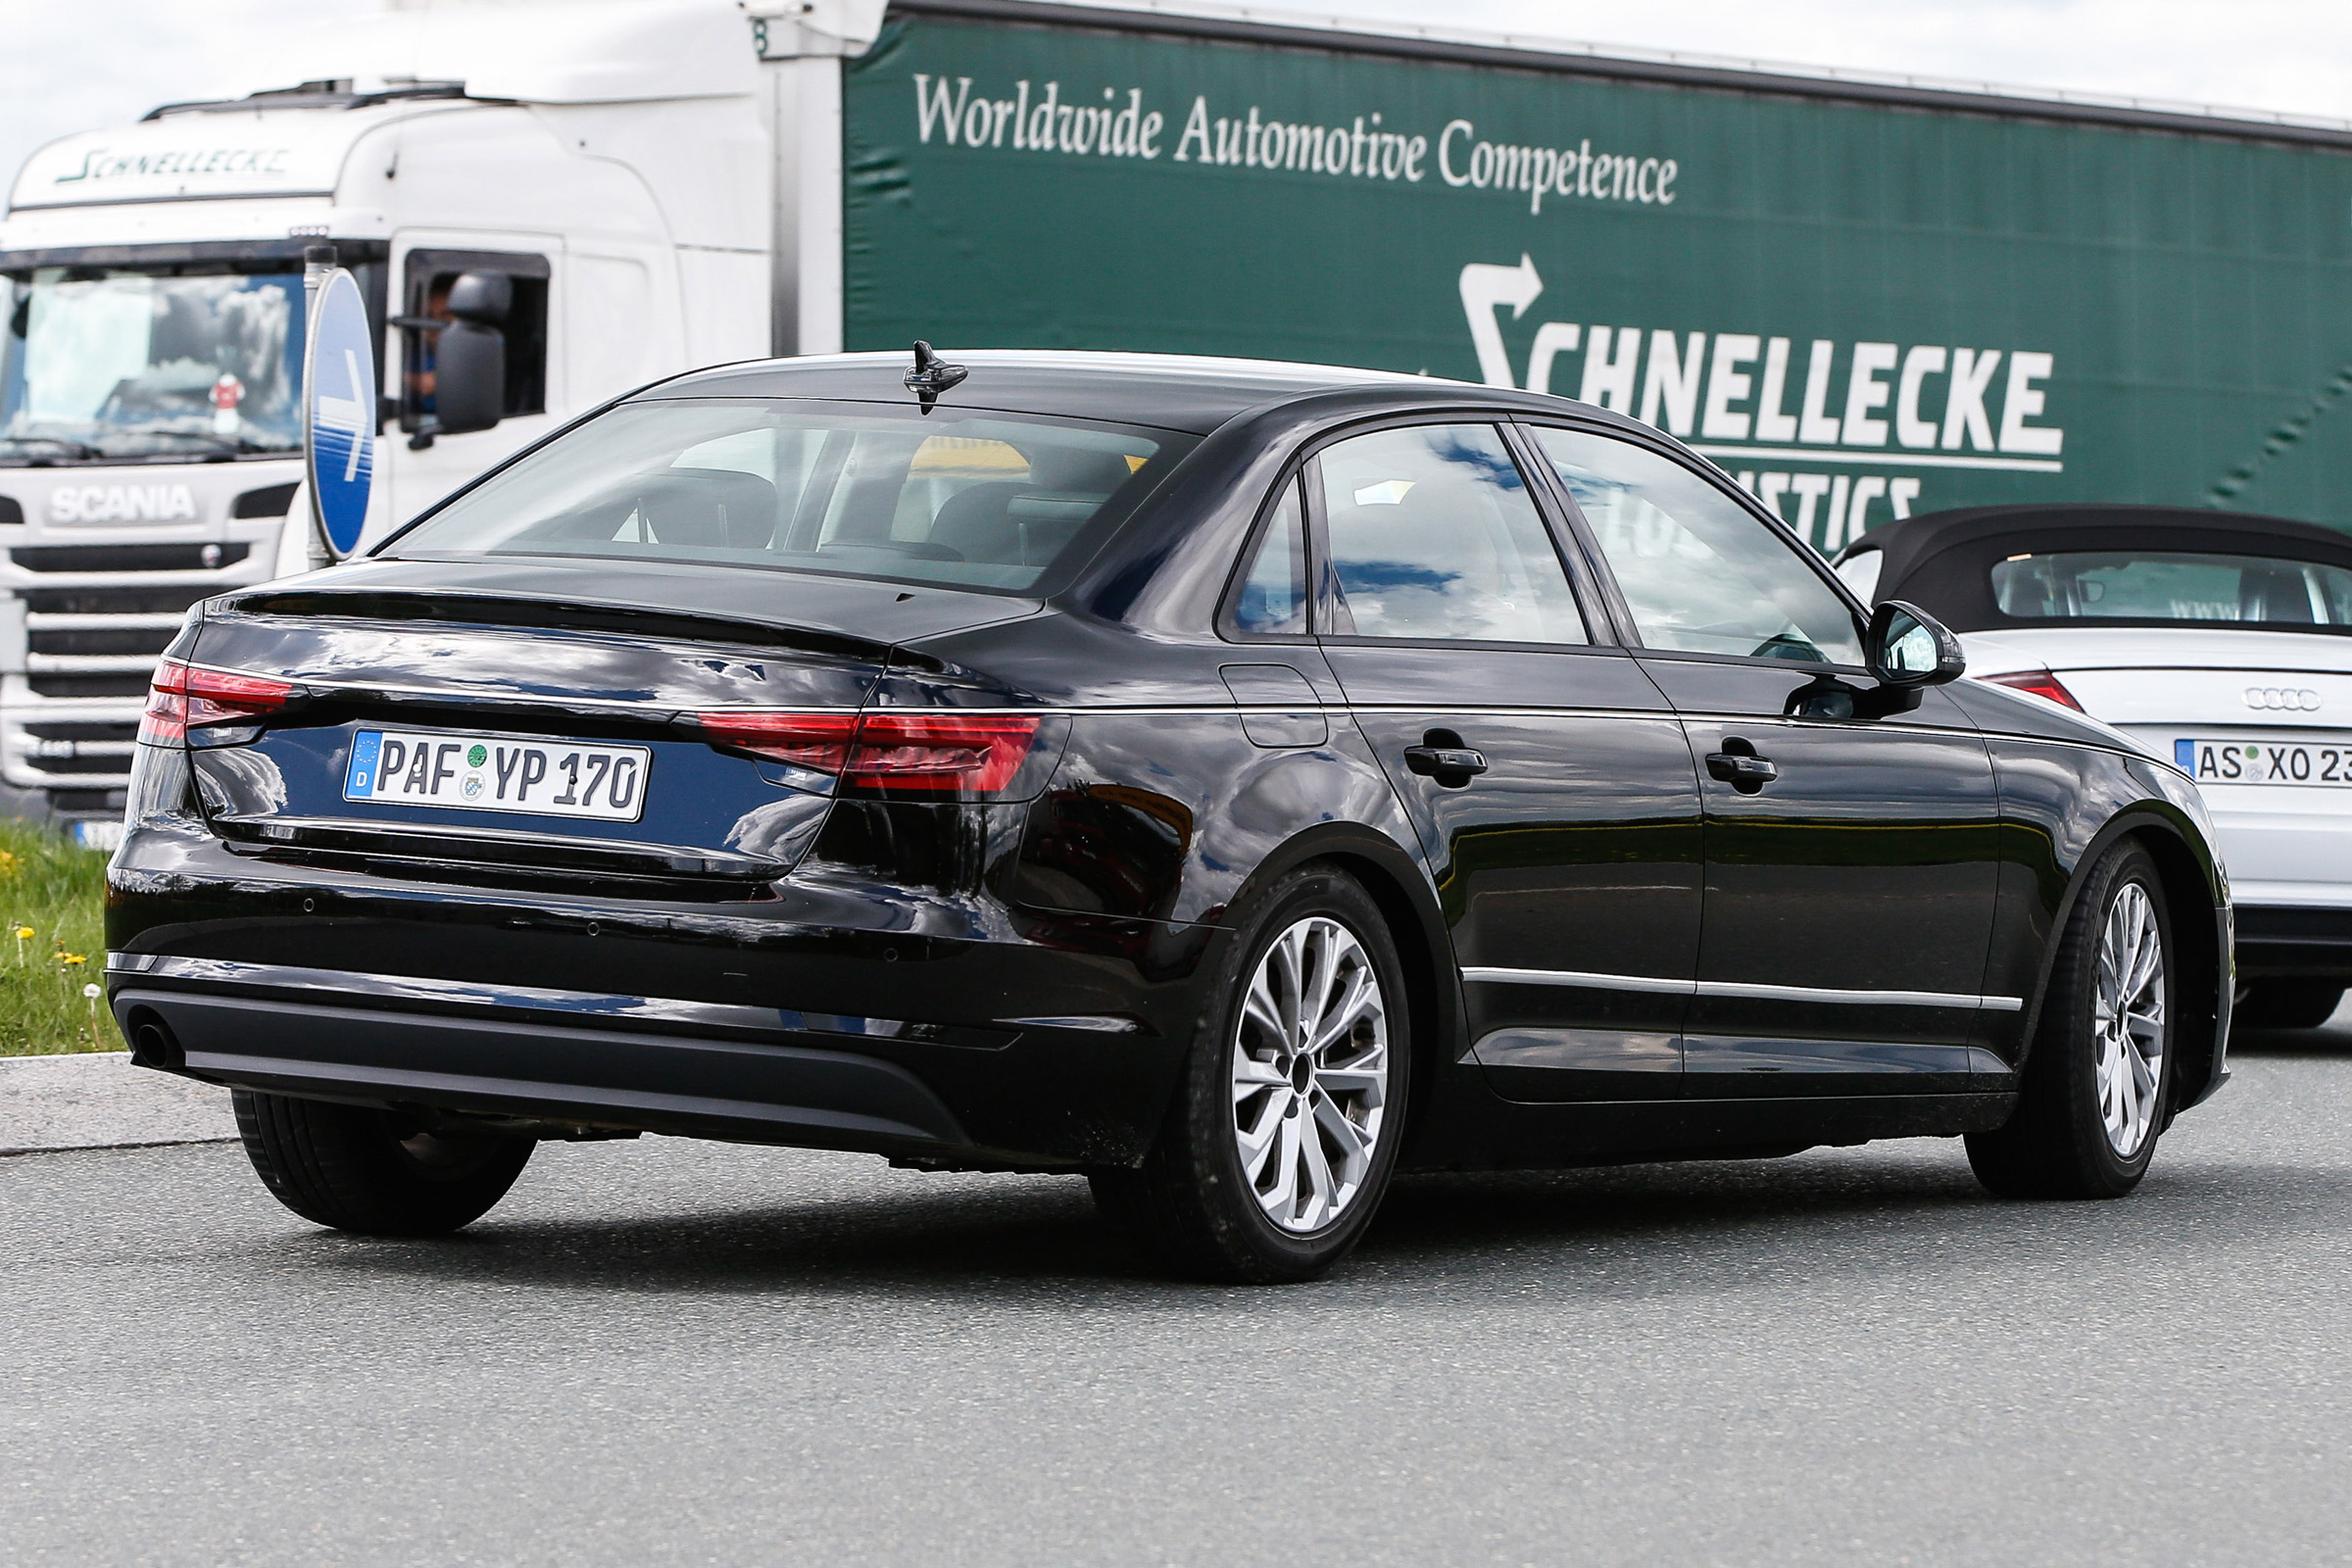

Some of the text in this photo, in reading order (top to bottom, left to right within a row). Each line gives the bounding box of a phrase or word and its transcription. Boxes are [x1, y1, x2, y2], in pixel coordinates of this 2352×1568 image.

[913, 74, 1678, 215] Worldwide Automotive Competence
[50, 484, 196, 523] SCANIA
[356, 739, 637, 808] D PAF YP 170
[2199, 746, 2241, 779] AS
